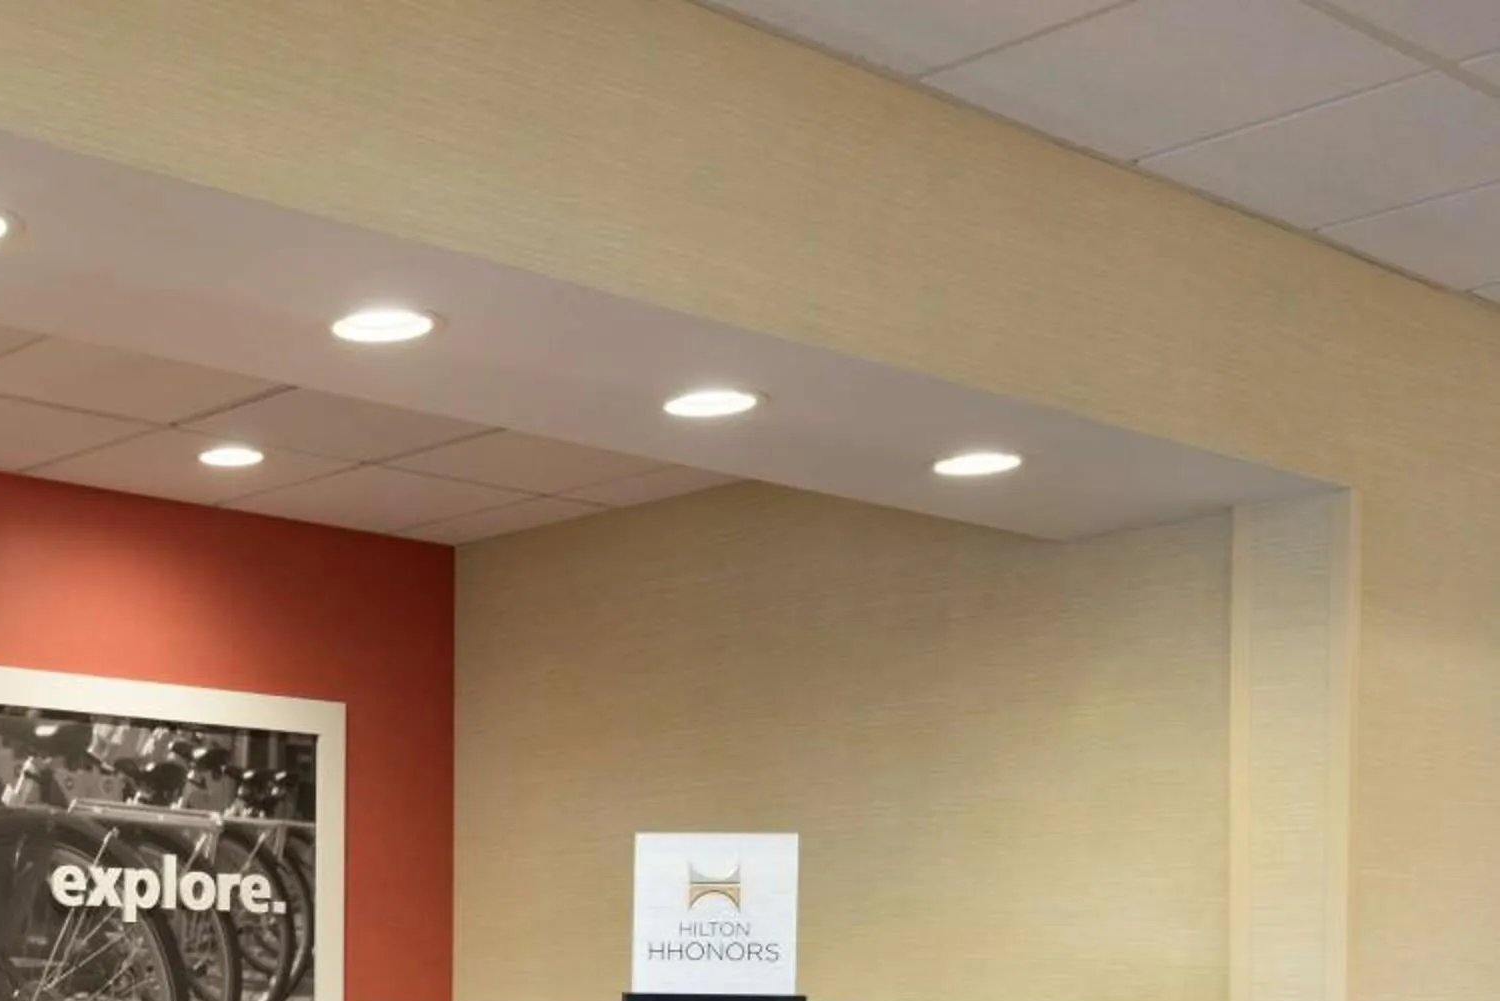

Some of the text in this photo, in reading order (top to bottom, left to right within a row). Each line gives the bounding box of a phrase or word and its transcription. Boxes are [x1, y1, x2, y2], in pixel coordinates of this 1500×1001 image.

[51, 853, 287, 922] explore.
[678, 921, 751, 937] HILTON
[648, 941, 780, 962] HHONORS
